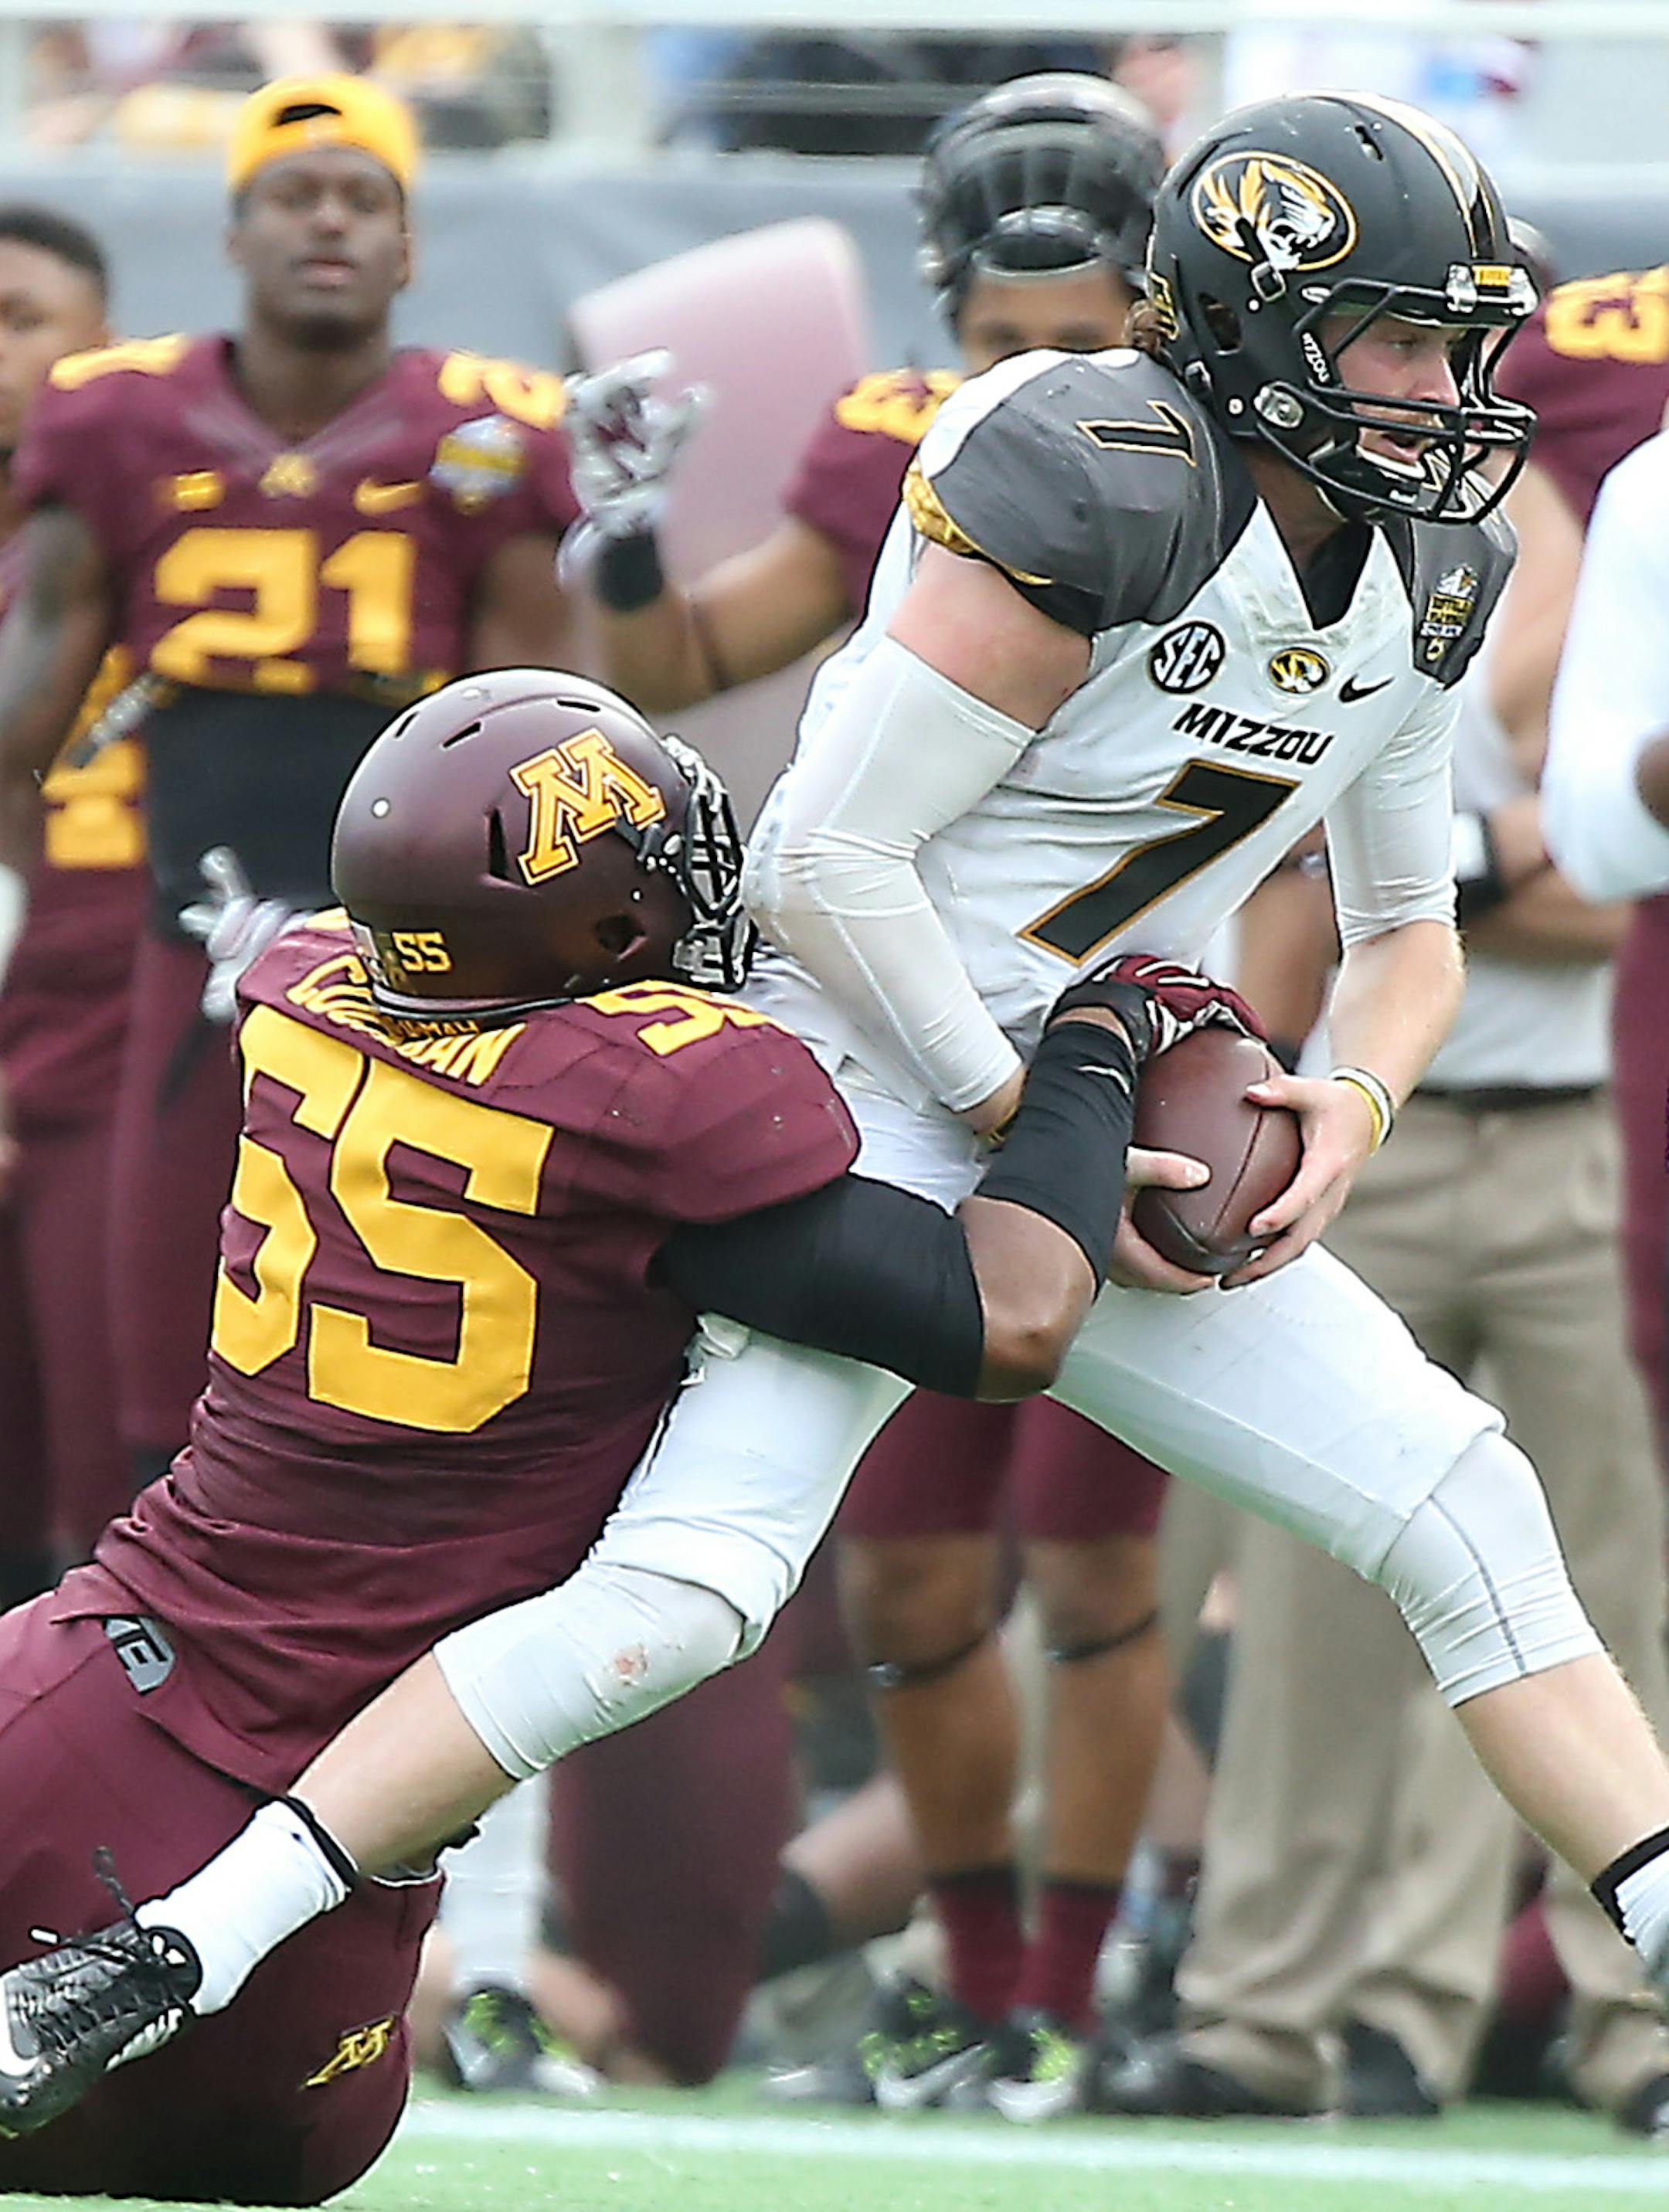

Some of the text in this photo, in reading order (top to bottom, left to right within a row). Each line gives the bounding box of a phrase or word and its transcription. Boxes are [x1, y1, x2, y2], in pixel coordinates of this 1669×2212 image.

[150, 525, 417, 694] 21
[1153, 624, 1222, 689] SEC
[508, 725, 668, 886] M
[1171, 701, 1336, 766] MIZZOU
[1014, 756, 1304, 969] 7
[392, 929, 454, 973] 55
[211, 1003, 555, 1433] 55
